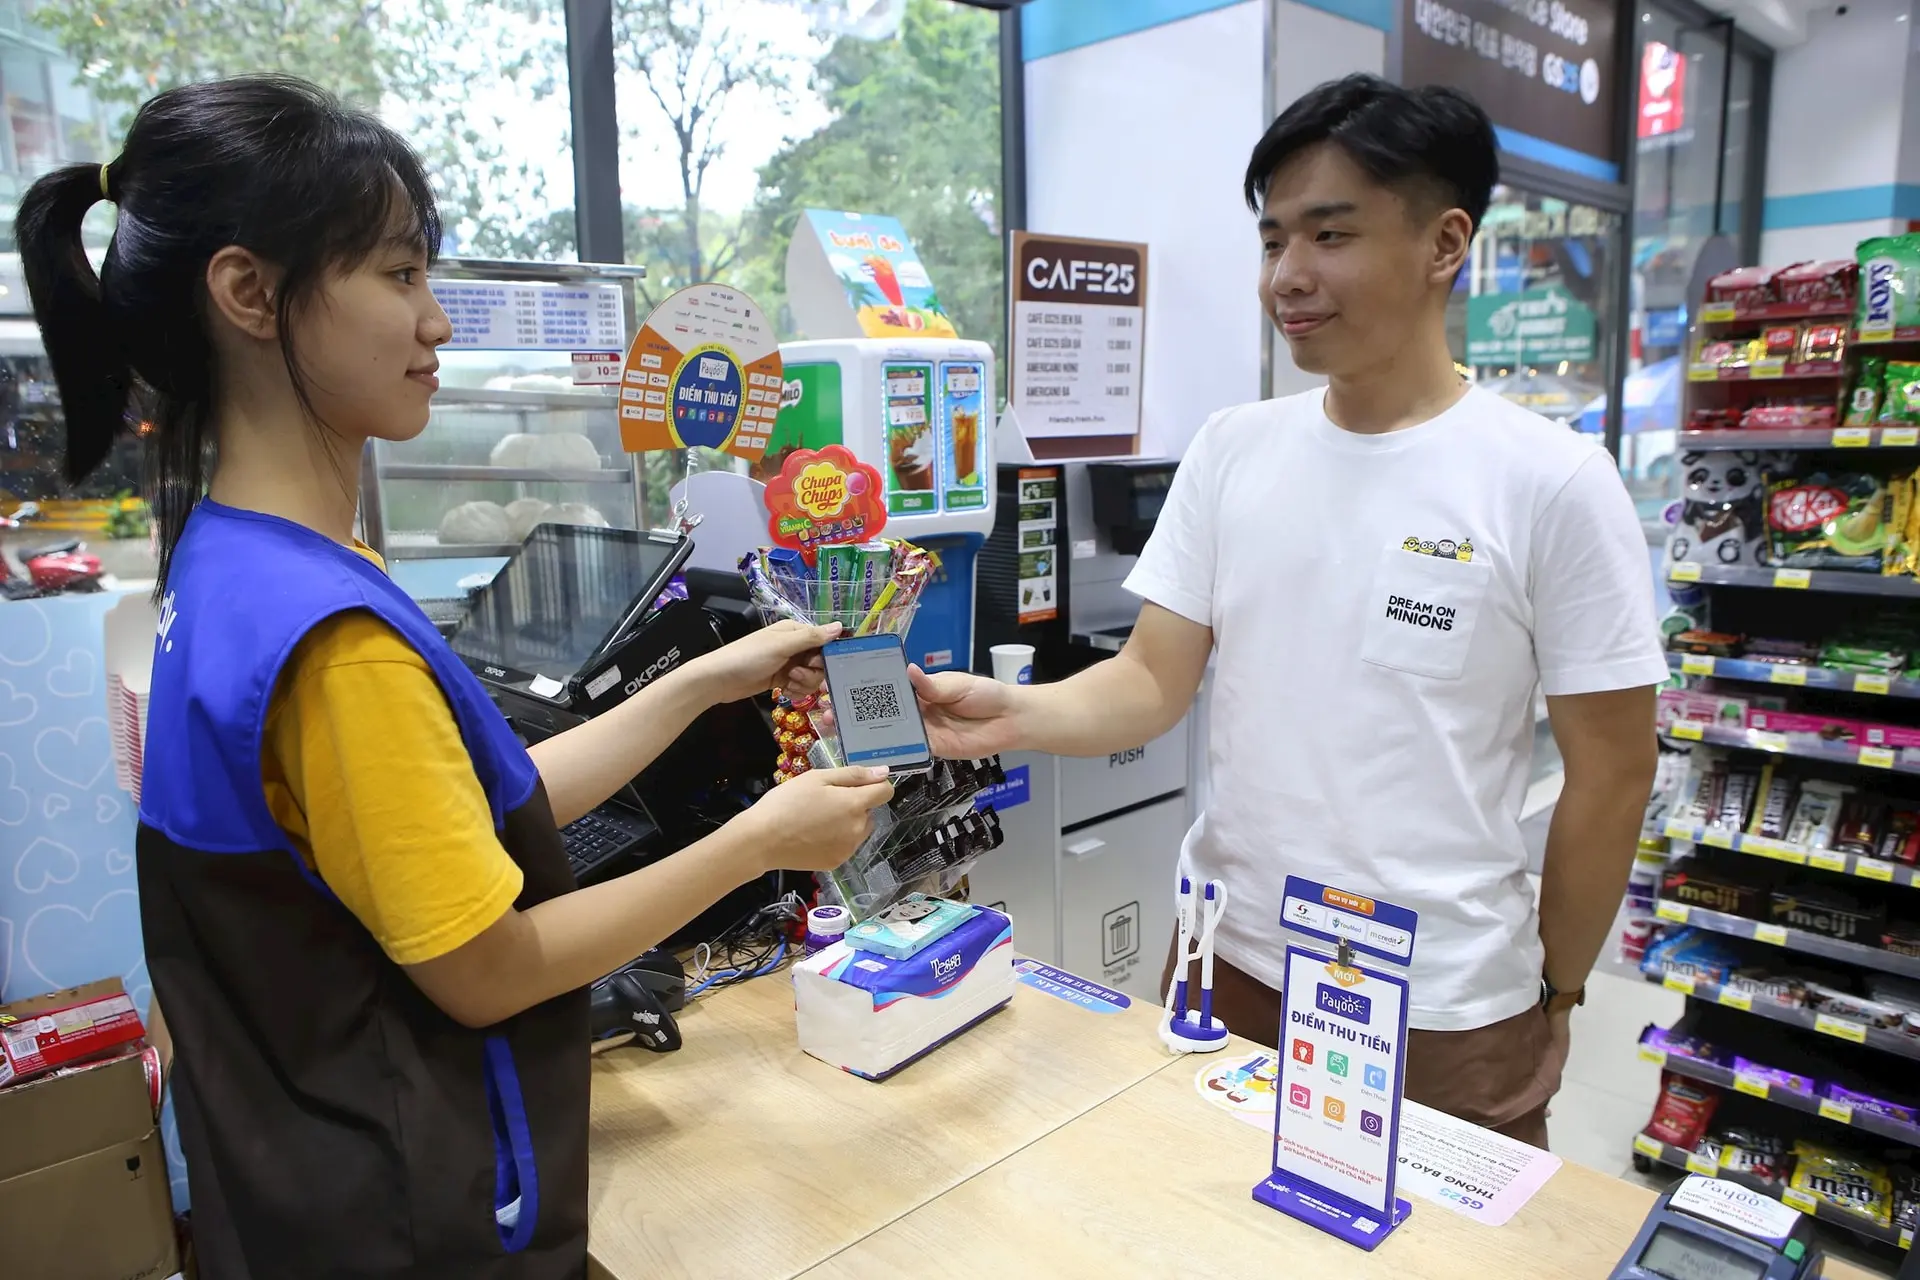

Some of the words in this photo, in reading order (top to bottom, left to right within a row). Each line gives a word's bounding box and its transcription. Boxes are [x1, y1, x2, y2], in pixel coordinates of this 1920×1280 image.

[1027, 257, 1135, 295] CAFE25
[679, 383, 702, 403] ĐIỂM
[704, 390, 720, 404] THU
[720, 390, 738, 407] TIỀN
[801, 474, 842, 493] Chupa
[801, 487, 843, 512] Chups
[780, 522, 804, 534] VITAMIN
[804, 518, 812, 529] C
[1388, 594, 1433, 614] DREAM
[1436, 606, 1456, 618] ON
[1386, 606, 1453, 631] MINIONS
[484, 666, 506, 677] OKPOS
[624, 645, 681, 696] OKPOS
[1109, 745, 1145, 768] PUSH
[1677, 884, 1740, 913] meiji
[1787, 906, 1857, 938] meiji
[930, 953, 962, 979] Tessa
[1334, 970, 1355, 983] MỚI
[1035, 979, 1060, 992] BÁN
[1073, 980, 1084, 988] XE
[1084, 984, 1102, 996] HIỂM
[1062, 987, 1093, 1005] ĐIỂM
[1321, 991, 1354, 1013] Payoo
[1291, 1011, 1325, 1032] ĐIỂM
[1329, 1023, 1356, 1041] THU
[1360, 1032, 1391, 1054] TIỀN
[1283, 1138, 1295, 1146] Dịch
[1329, 1156, 1344, 1166] thanh
[1345, 1163, 1357, 1172] toán
[1366, 1172, 1382, 1183] ngoài
[1410, 1160, 1441, 1178] BÁO
[1497, 1161, 1521, 1173] Mong
[1443, 1174, 1495, 1200] THÔNG
[1479, 1180, 1503, 1191] MUST
[1701, 1180, 1759, 1206] Payoo
[1438, 1187, 1484, 1209] GS25
